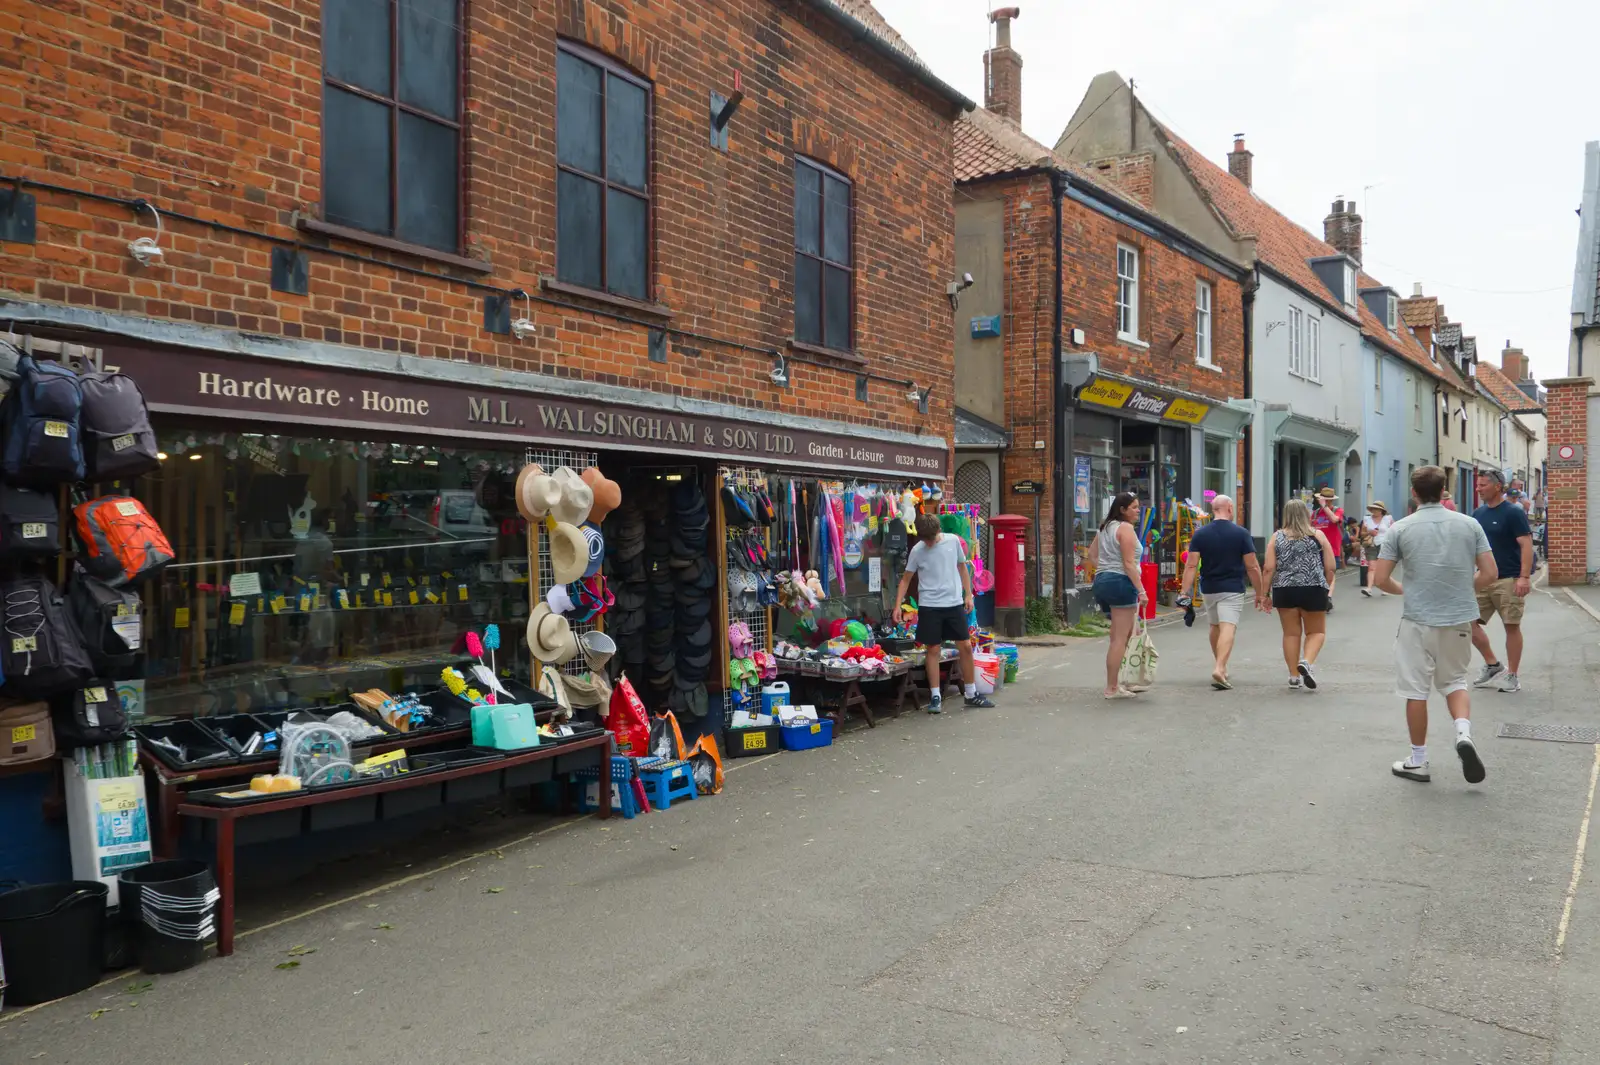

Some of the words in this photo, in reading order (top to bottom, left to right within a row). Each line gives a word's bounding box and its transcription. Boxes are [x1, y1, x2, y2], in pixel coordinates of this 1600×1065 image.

[198, 371, 341, 407] Hardware
[361, 390, 430, 416] Home
[1108, 388, 1124, 401] Store
[1128, 391, 1168, 414] Premier
[467, 396, 524, 426] M.L.
[537, 404, 695, 444] WALSINGHAM
[703, 426, 716, 447] &
[723, 428, 758, 450] SON
[765, 433, 797, 455] LTD.
[808, 441, 844, 459] Garden
[850, 447, 885, 463] Leisure
[895, 454, 914, 467] 01328
[916, 457, 939, 469] 710438
[745, 739, 764, 749] £4.99
